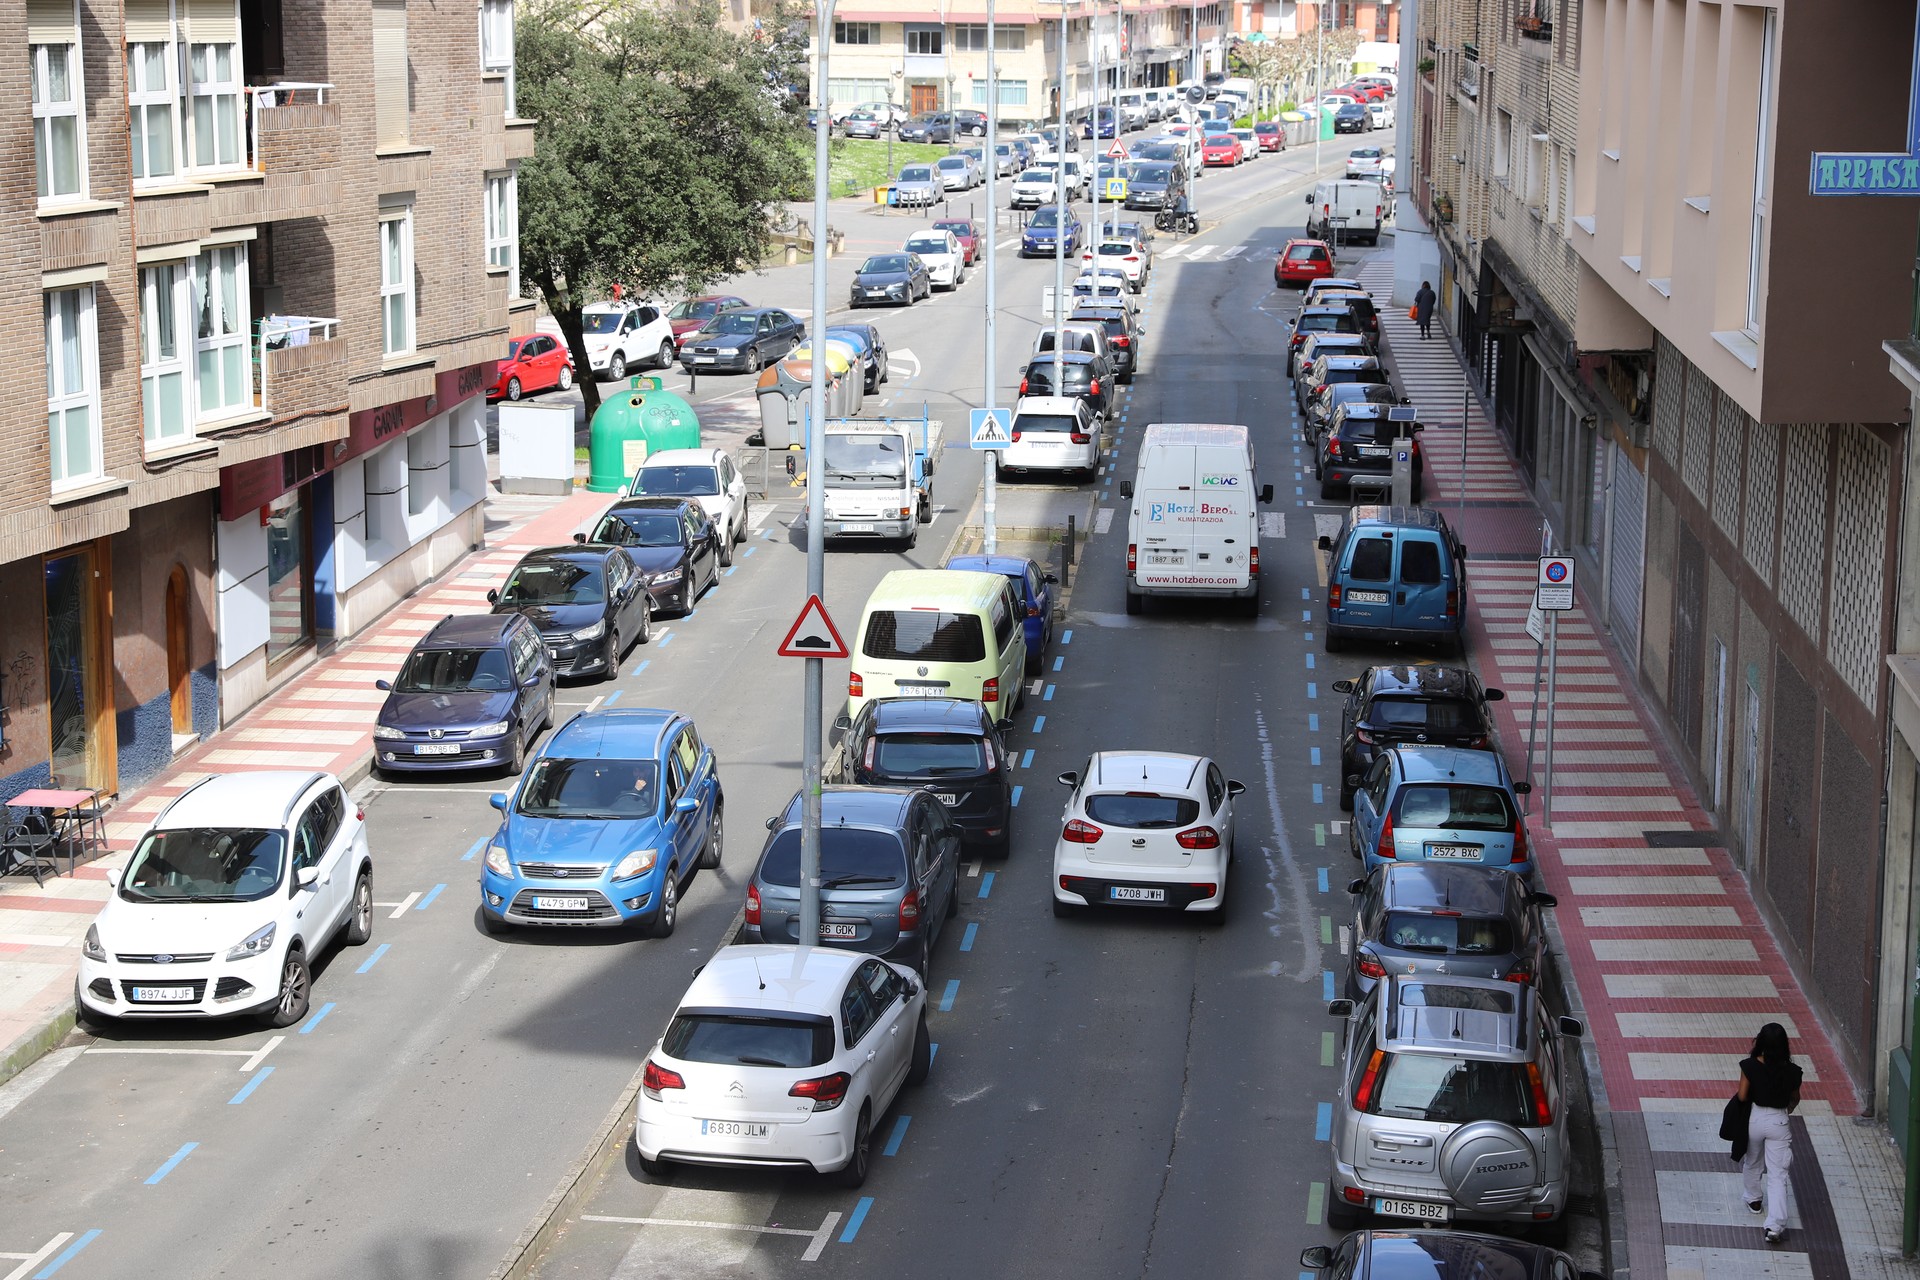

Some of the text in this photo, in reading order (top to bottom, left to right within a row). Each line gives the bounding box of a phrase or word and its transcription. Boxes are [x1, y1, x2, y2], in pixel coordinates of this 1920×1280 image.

[1819, 159, 1920, 189] ARRASA
[1399, 452, 1406, 461] P
[1167, 503, 1194, 513] HOTZ
[1147, 575, 1237, 584] www.hotzbero.com
[1433, 847, 1478, 858] 2572 BXC
[1117, 889, 1162, 899] 4708 JWH
[540, 899, 586, 908] 4479 GPM
[819, 924, 854, 935] 96 GDK
[140, 989, 191, 999] 8974 JJF
[709, 1122, 767, 1136] 6830 JLM
[1476, 1161, 1530, 1174] HONDA
[1384, 1200, 1443, 1218] 0165 BBZ
